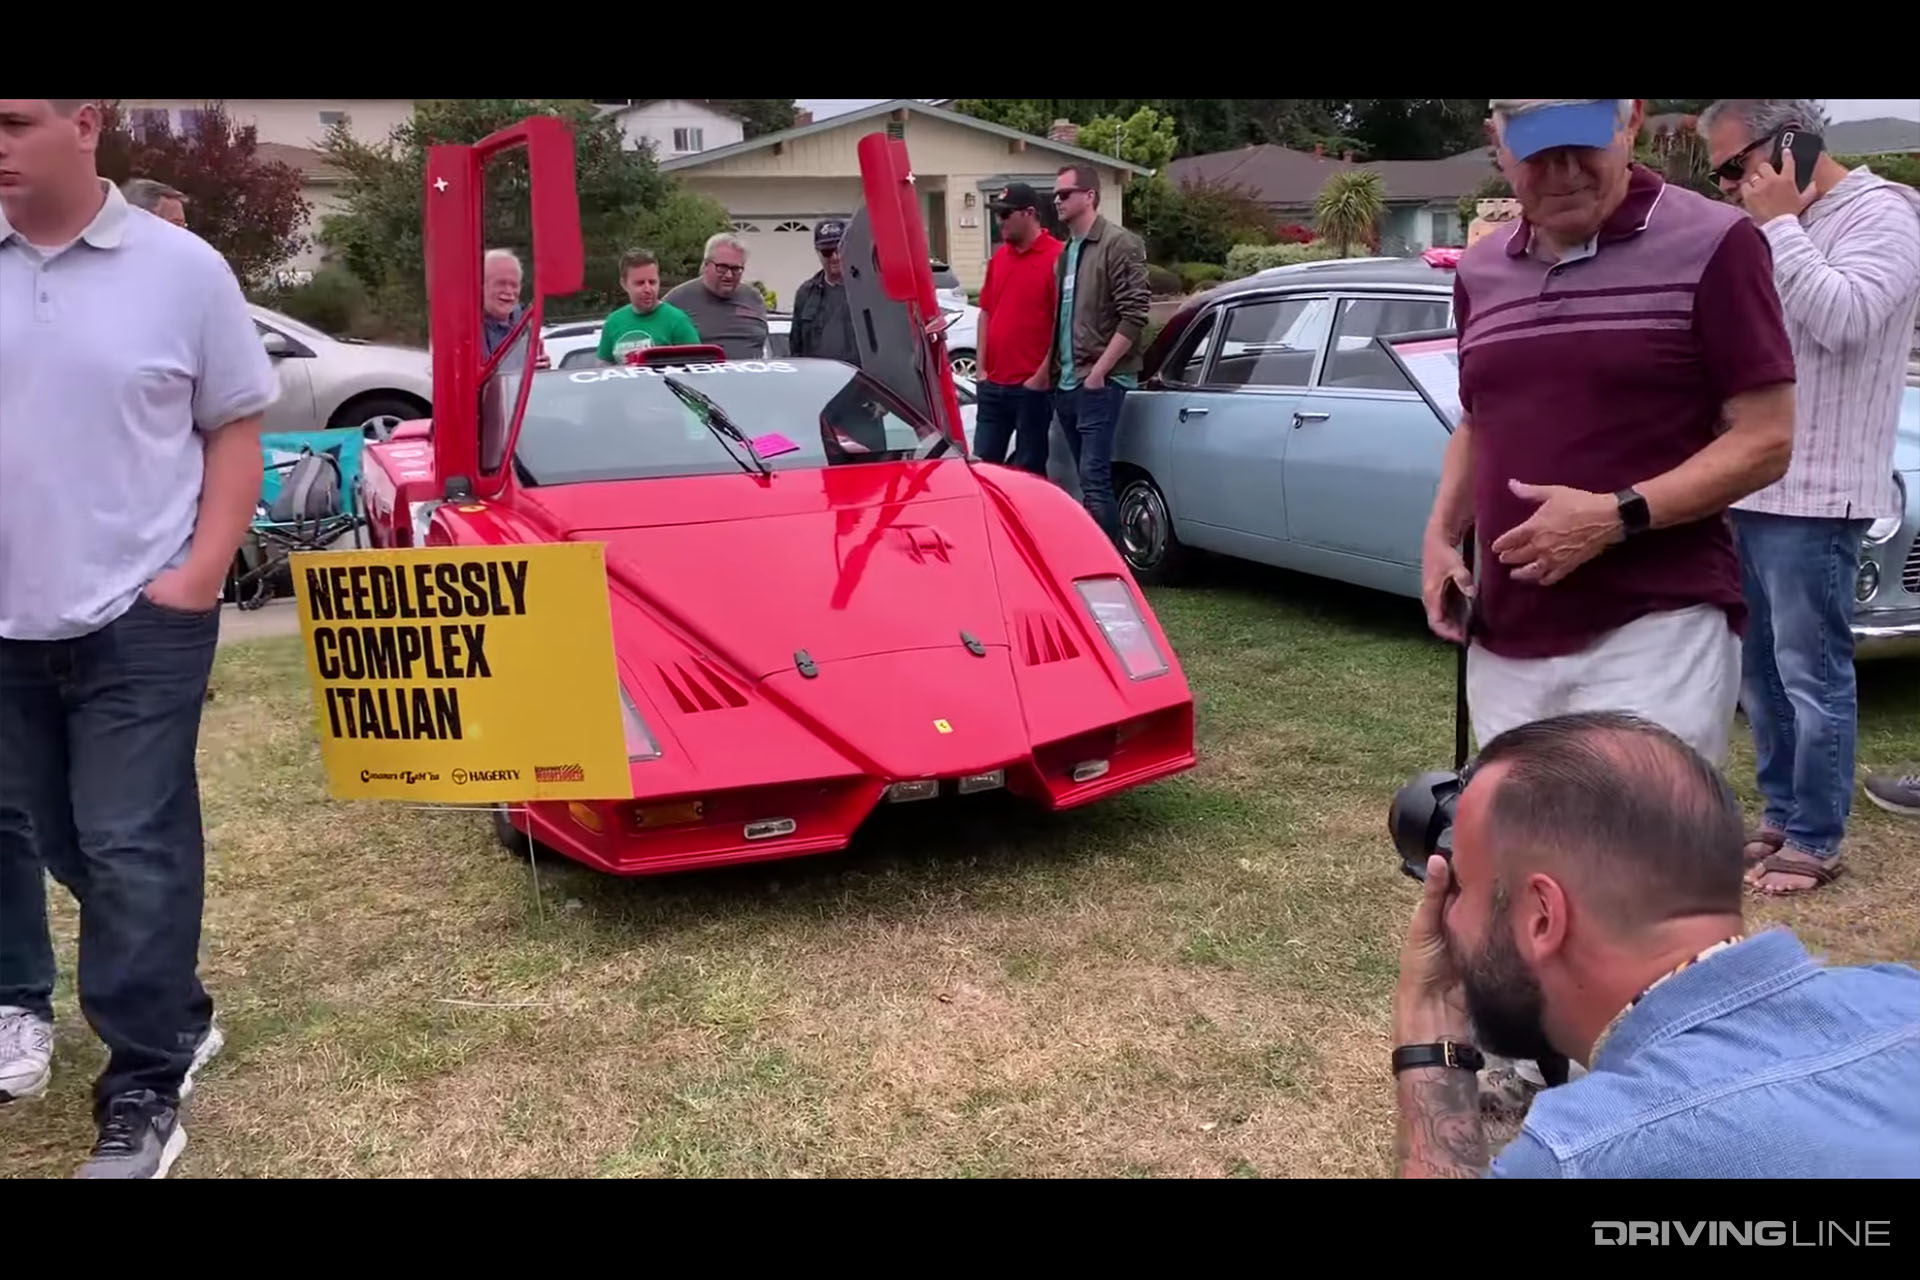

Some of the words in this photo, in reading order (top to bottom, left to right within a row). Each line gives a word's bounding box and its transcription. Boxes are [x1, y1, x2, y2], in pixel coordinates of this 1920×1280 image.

[307, 562, 527, 619] NEEDLESSLY
[315, 625, 491, 679] COMPLEX
[326, 688, 462, 740] ITALIAN
[468, 770, 520, 782] HAGERTY
